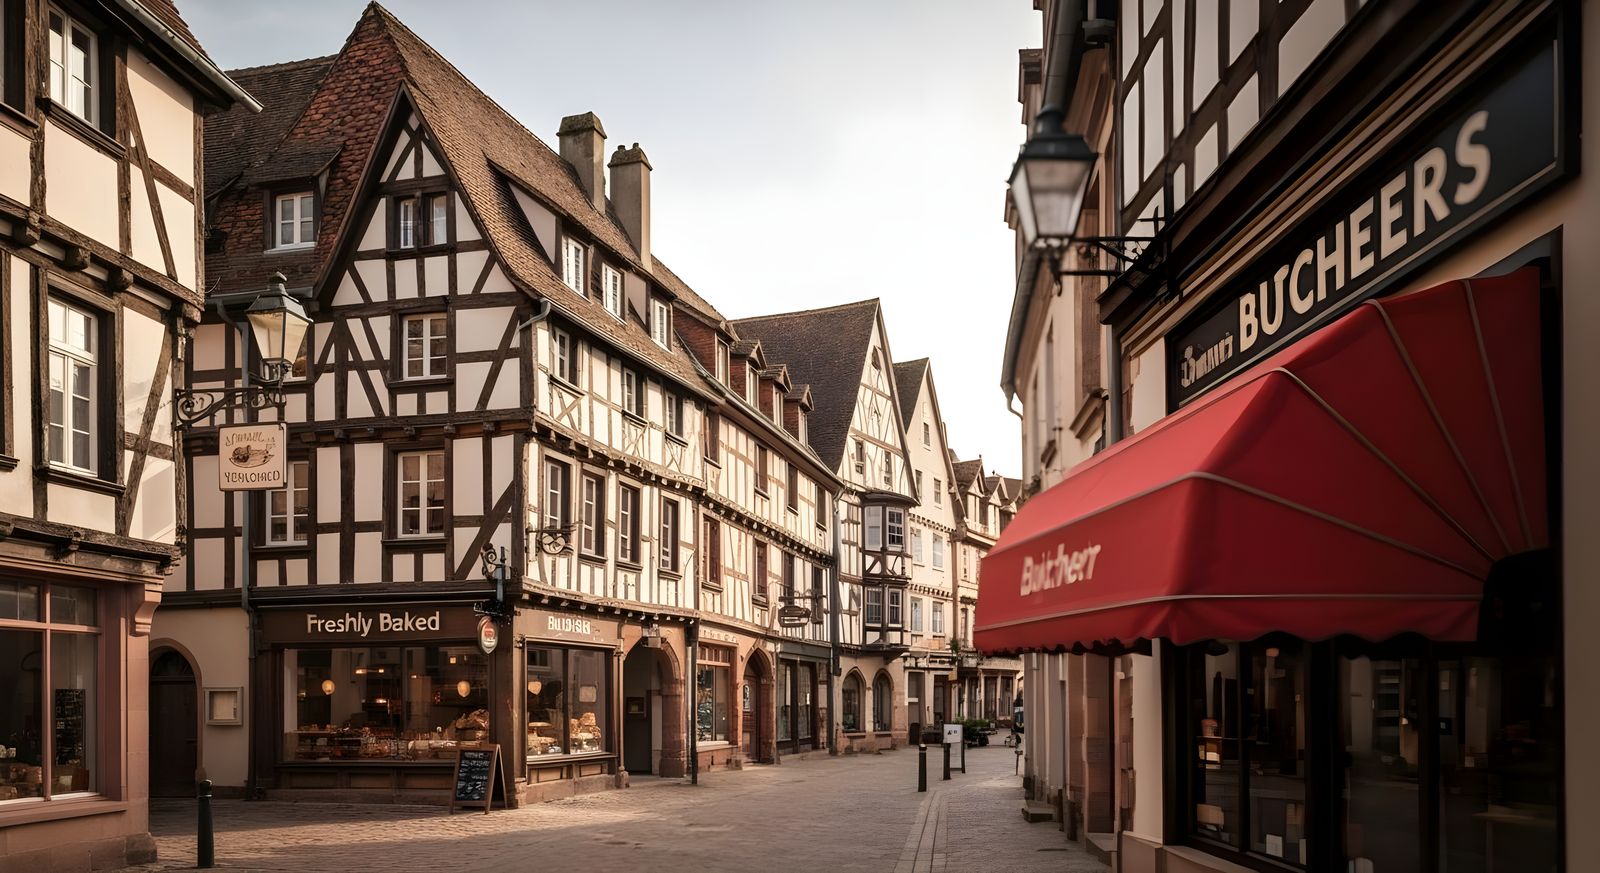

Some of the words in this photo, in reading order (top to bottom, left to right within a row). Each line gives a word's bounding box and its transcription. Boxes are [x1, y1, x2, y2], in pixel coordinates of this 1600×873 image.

[1239, 110, 1491, 353] BUCHEERS
[306, 611, 373, 637] Freshly
[379, 611, 440, 632] Baked
